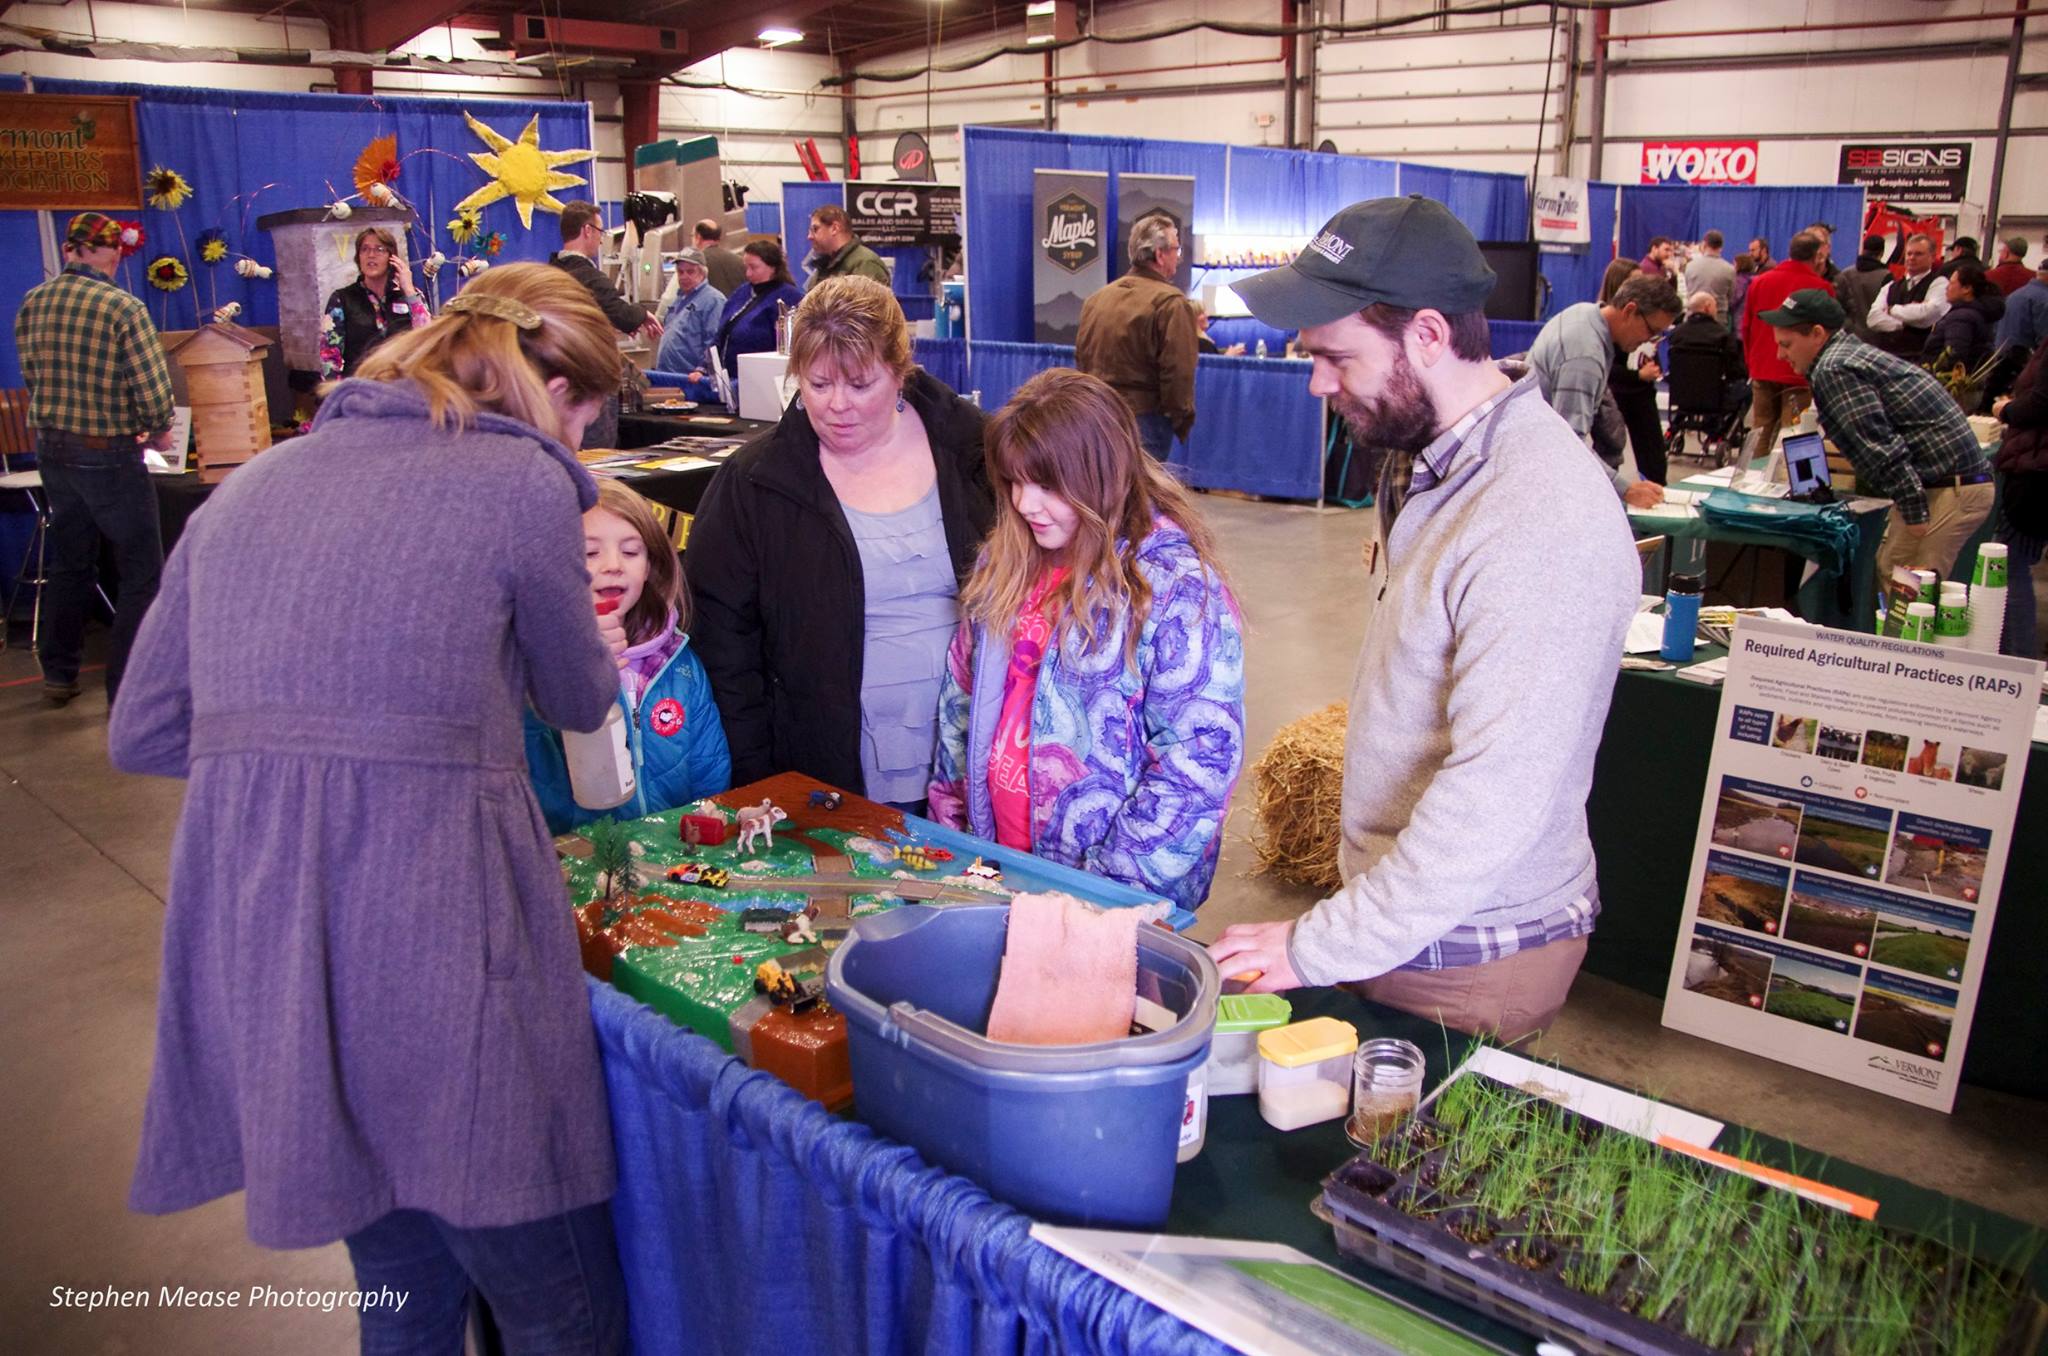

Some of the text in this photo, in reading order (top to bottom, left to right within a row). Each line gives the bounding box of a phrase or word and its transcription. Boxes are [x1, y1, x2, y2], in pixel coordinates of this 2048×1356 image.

[1646, 146, 1756, 181] WOKO
[856, 191, 918, 216] CCR
[1042, 213, 1096, 249] Maple
[1816, 631, 1944, 658] WATER QUALITY REGULATIONS
[1744, 638, 2023, 697] Required Agricultural Practices (RAPs)
